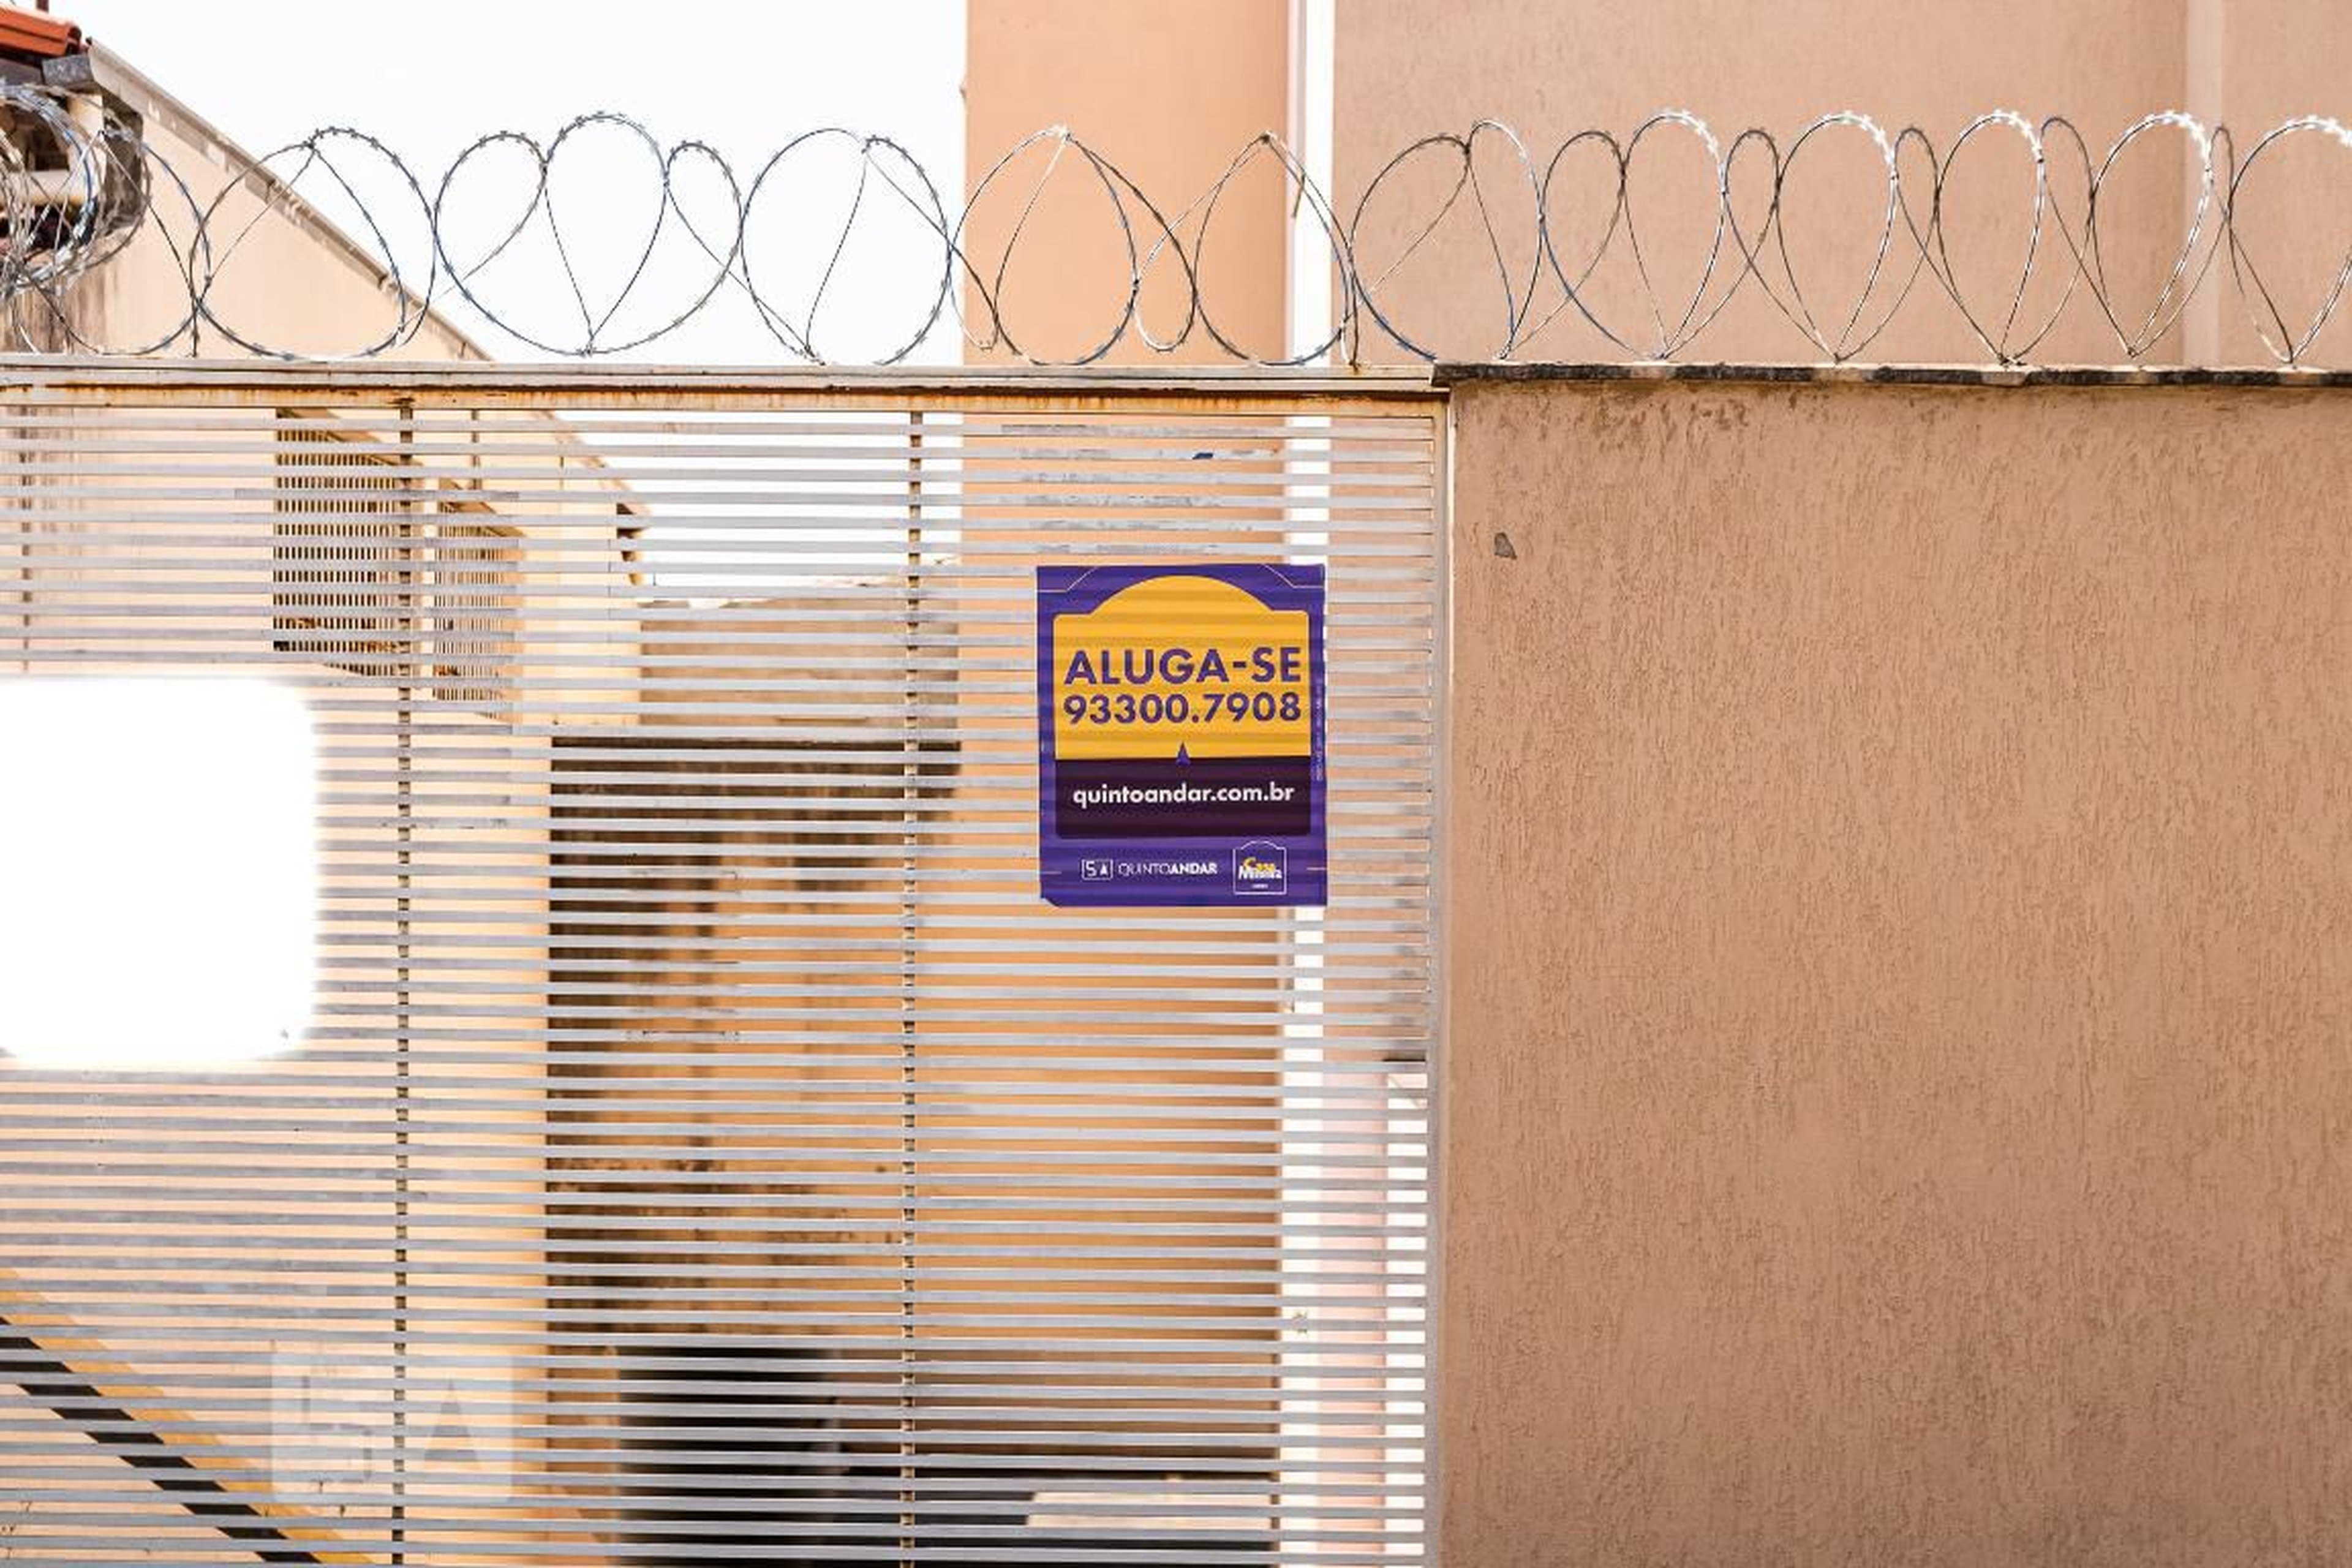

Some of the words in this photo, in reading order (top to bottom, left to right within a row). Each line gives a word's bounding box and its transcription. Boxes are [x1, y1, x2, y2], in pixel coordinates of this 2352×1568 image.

[1064, 647, 1301, 685] ALUGA-SE
[1064, 692, 1301, 725] 93300.7908
[1073, 782, 1295, 809] quintoandar.com.br
[1118, 862, 1218, 876] QUINTOANDAR
